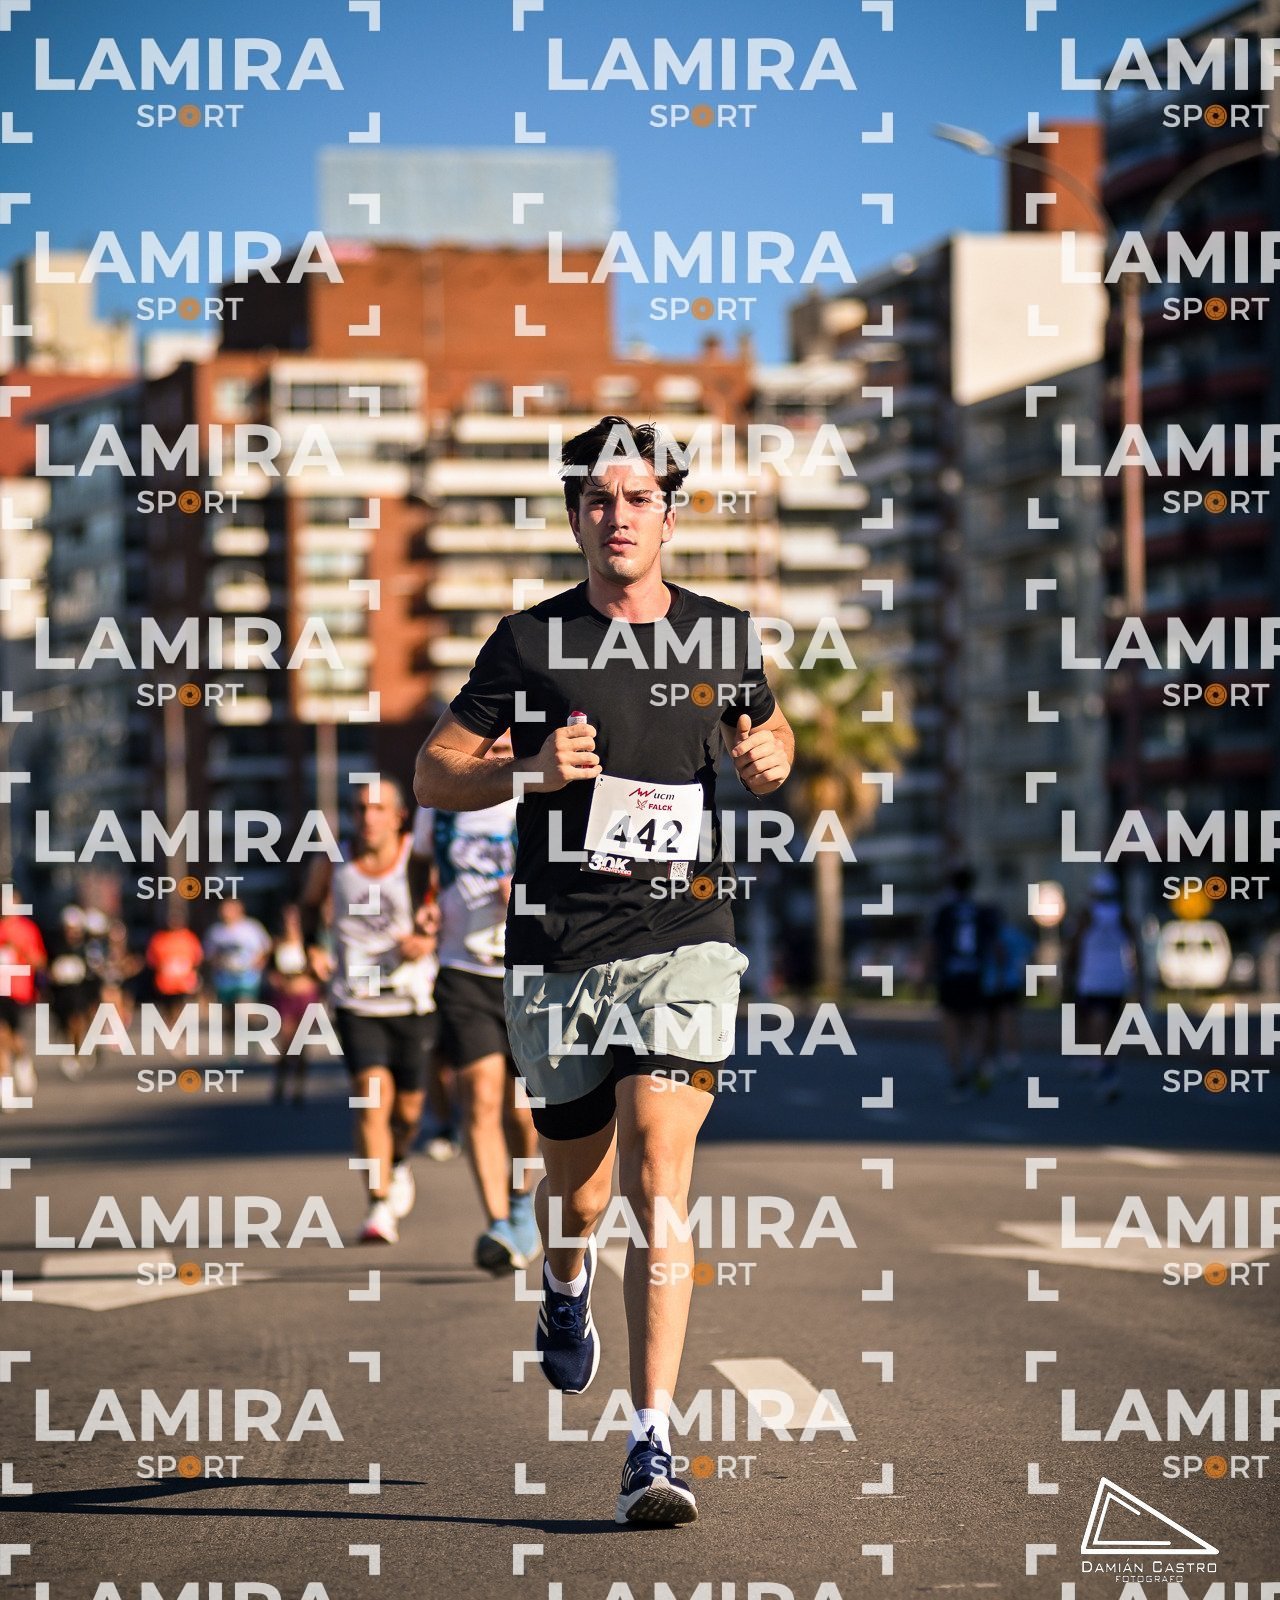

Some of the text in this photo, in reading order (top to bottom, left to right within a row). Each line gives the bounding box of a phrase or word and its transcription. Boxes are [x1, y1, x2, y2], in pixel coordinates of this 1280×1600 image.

[648, 803, 673, 811] FALCK
[606, 815, 683, 854] 442
[588, 853, 631, 871] 30K
